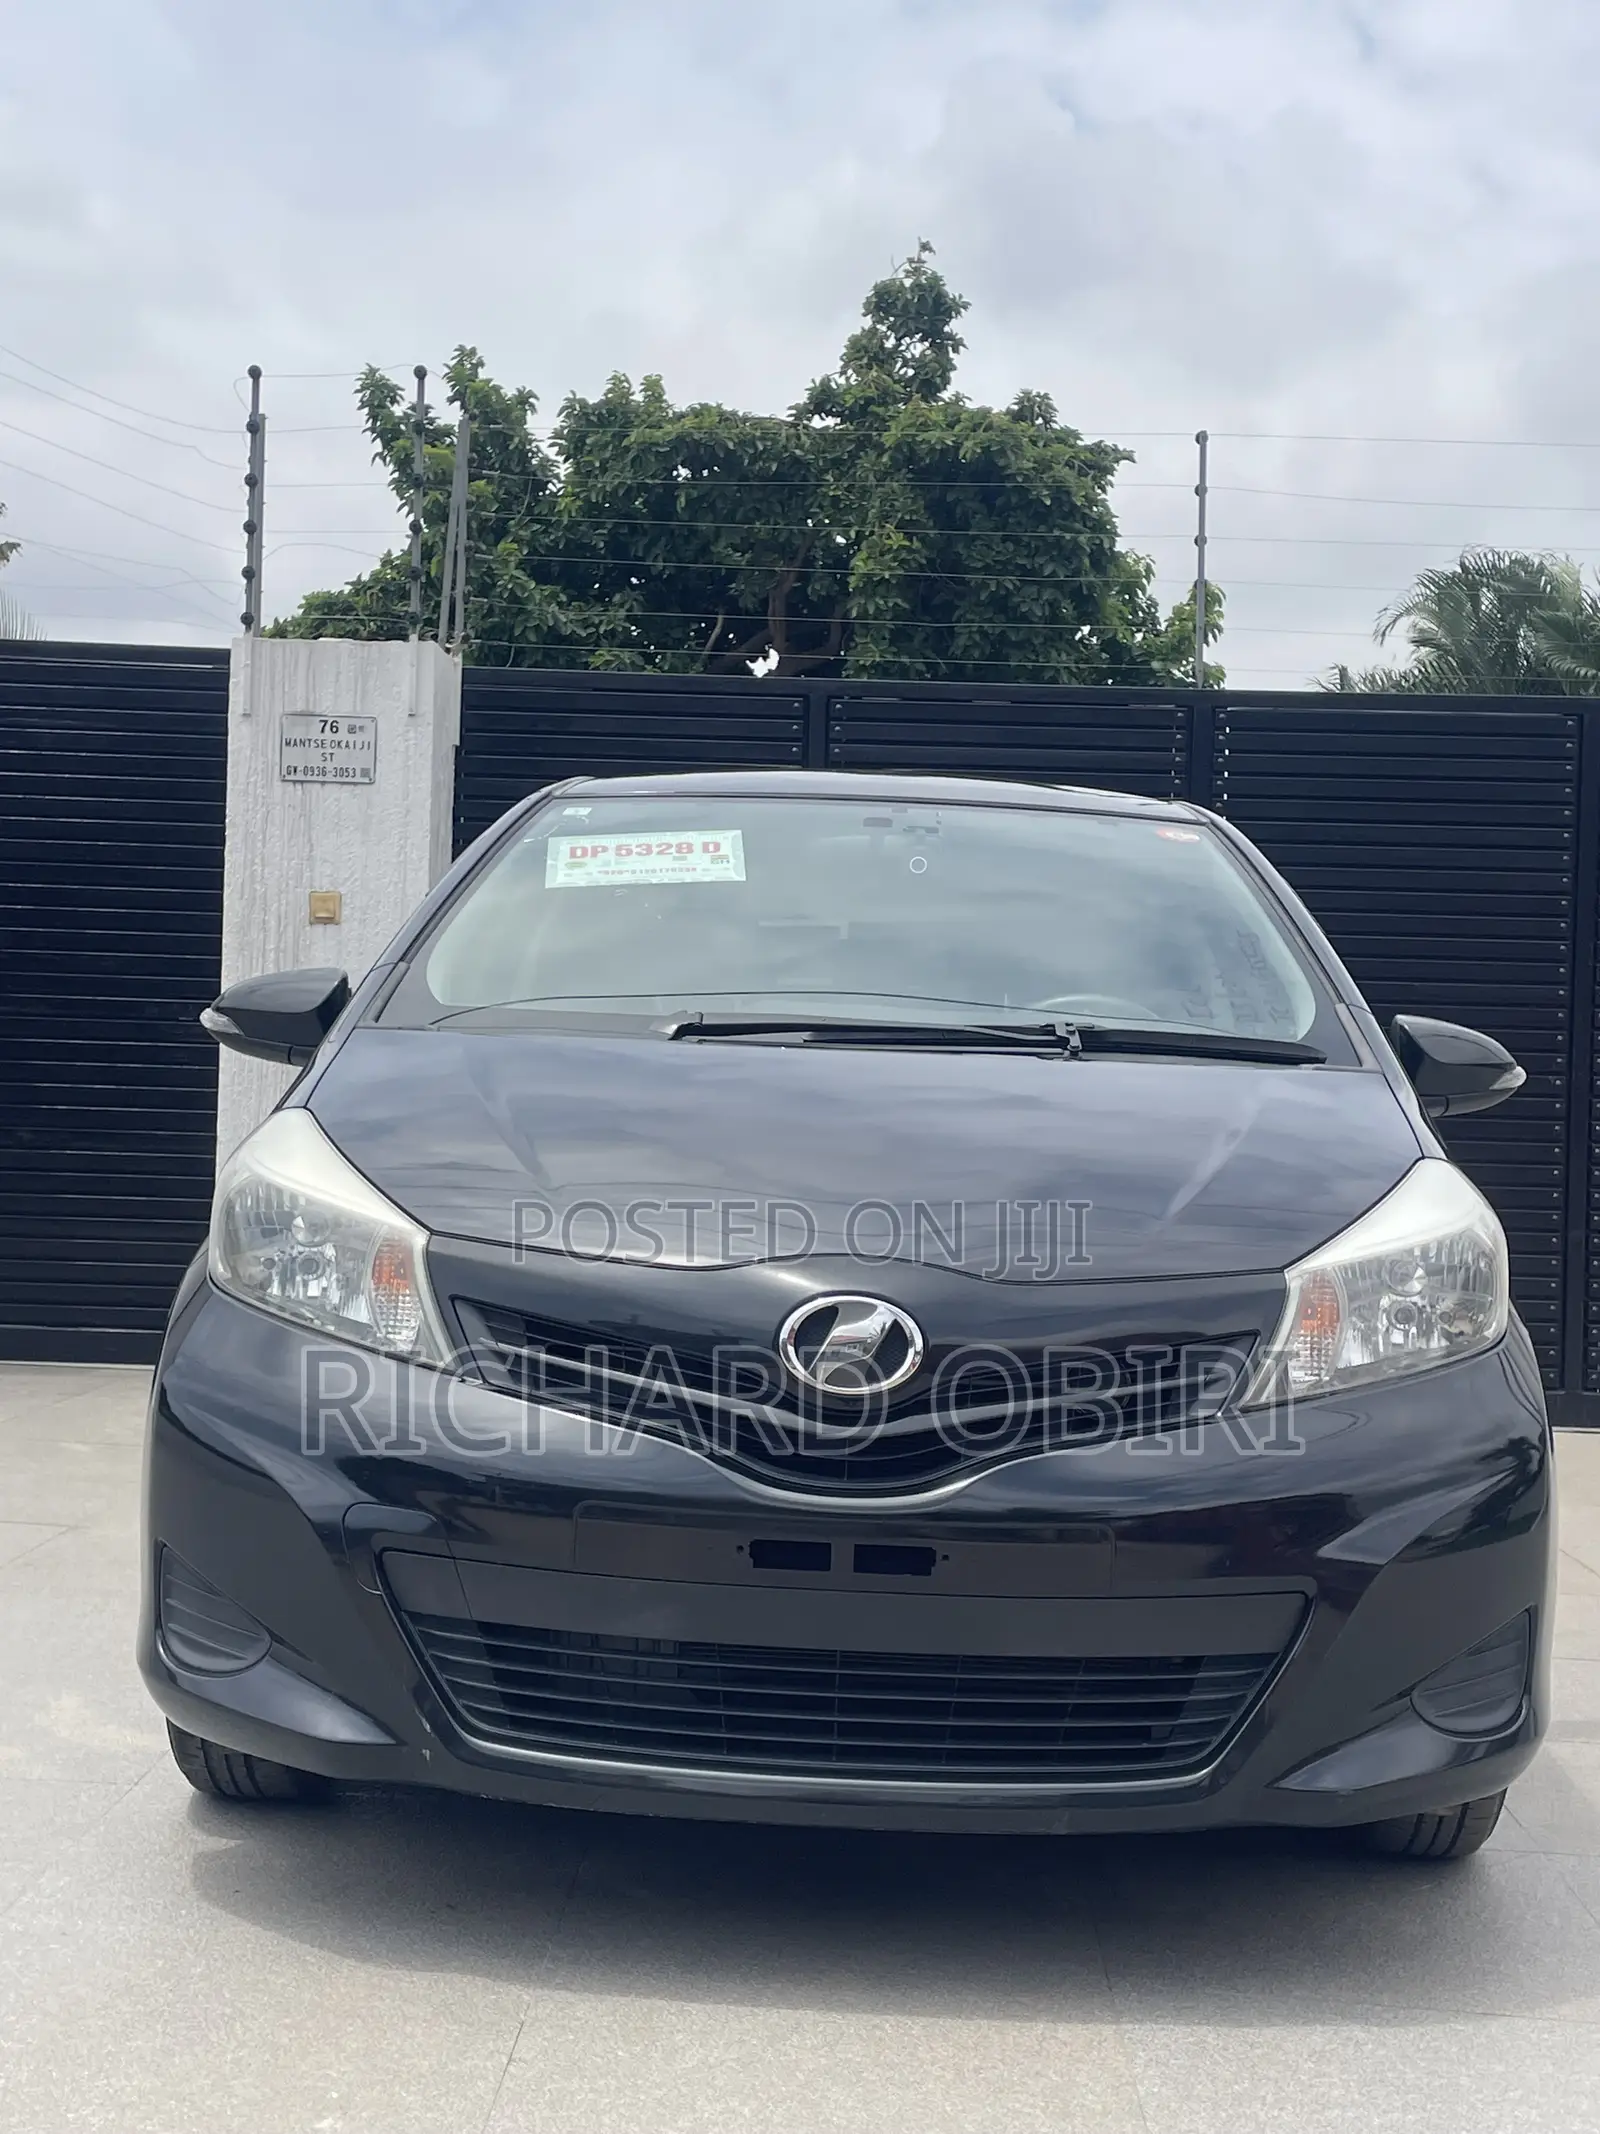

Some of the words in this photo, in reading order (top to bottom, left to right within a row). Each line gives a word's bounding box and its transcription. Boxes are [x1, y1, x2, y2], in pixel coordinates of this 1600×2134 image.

[319, 719, 340, 734] 76
[321, 752, 335, 762] ST
[286, 765, 357, 778] GW-0936-3053
[569, 845, 609, 860] DP
[614, 842, 694, 857] 5328
[702, 841, 721, 855] D
